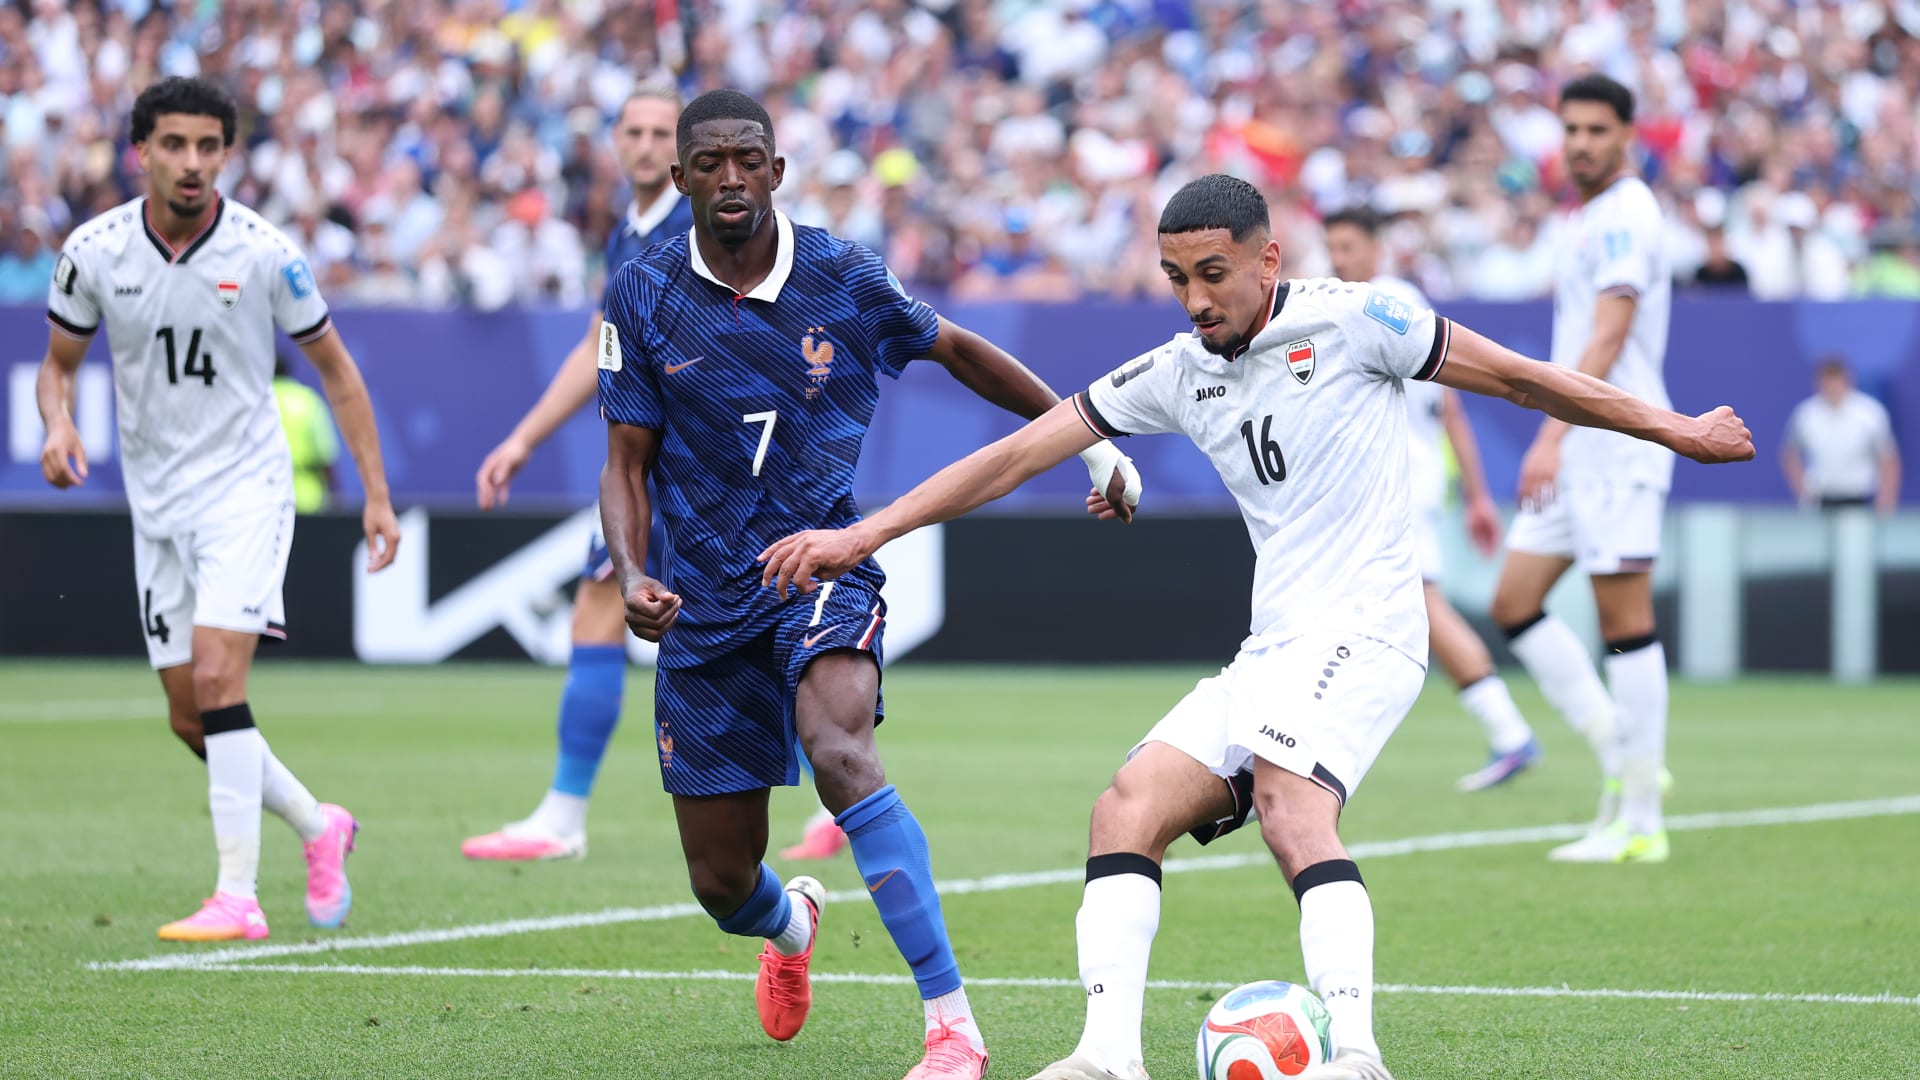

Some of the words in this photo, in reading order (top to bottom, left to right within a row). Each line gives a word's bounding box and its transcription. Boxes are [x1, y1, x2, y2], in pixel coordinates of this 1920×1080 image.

[156, 328, 216, 385] 14
[1291, 342, 1308, 351] IRAQ
[1195, 385, 1226, 402] JAKO
[743, 409, 777, 477] 7
[1240, 414, 1286, 485] 16
[1258, 724, 1296, 748] JAKO
